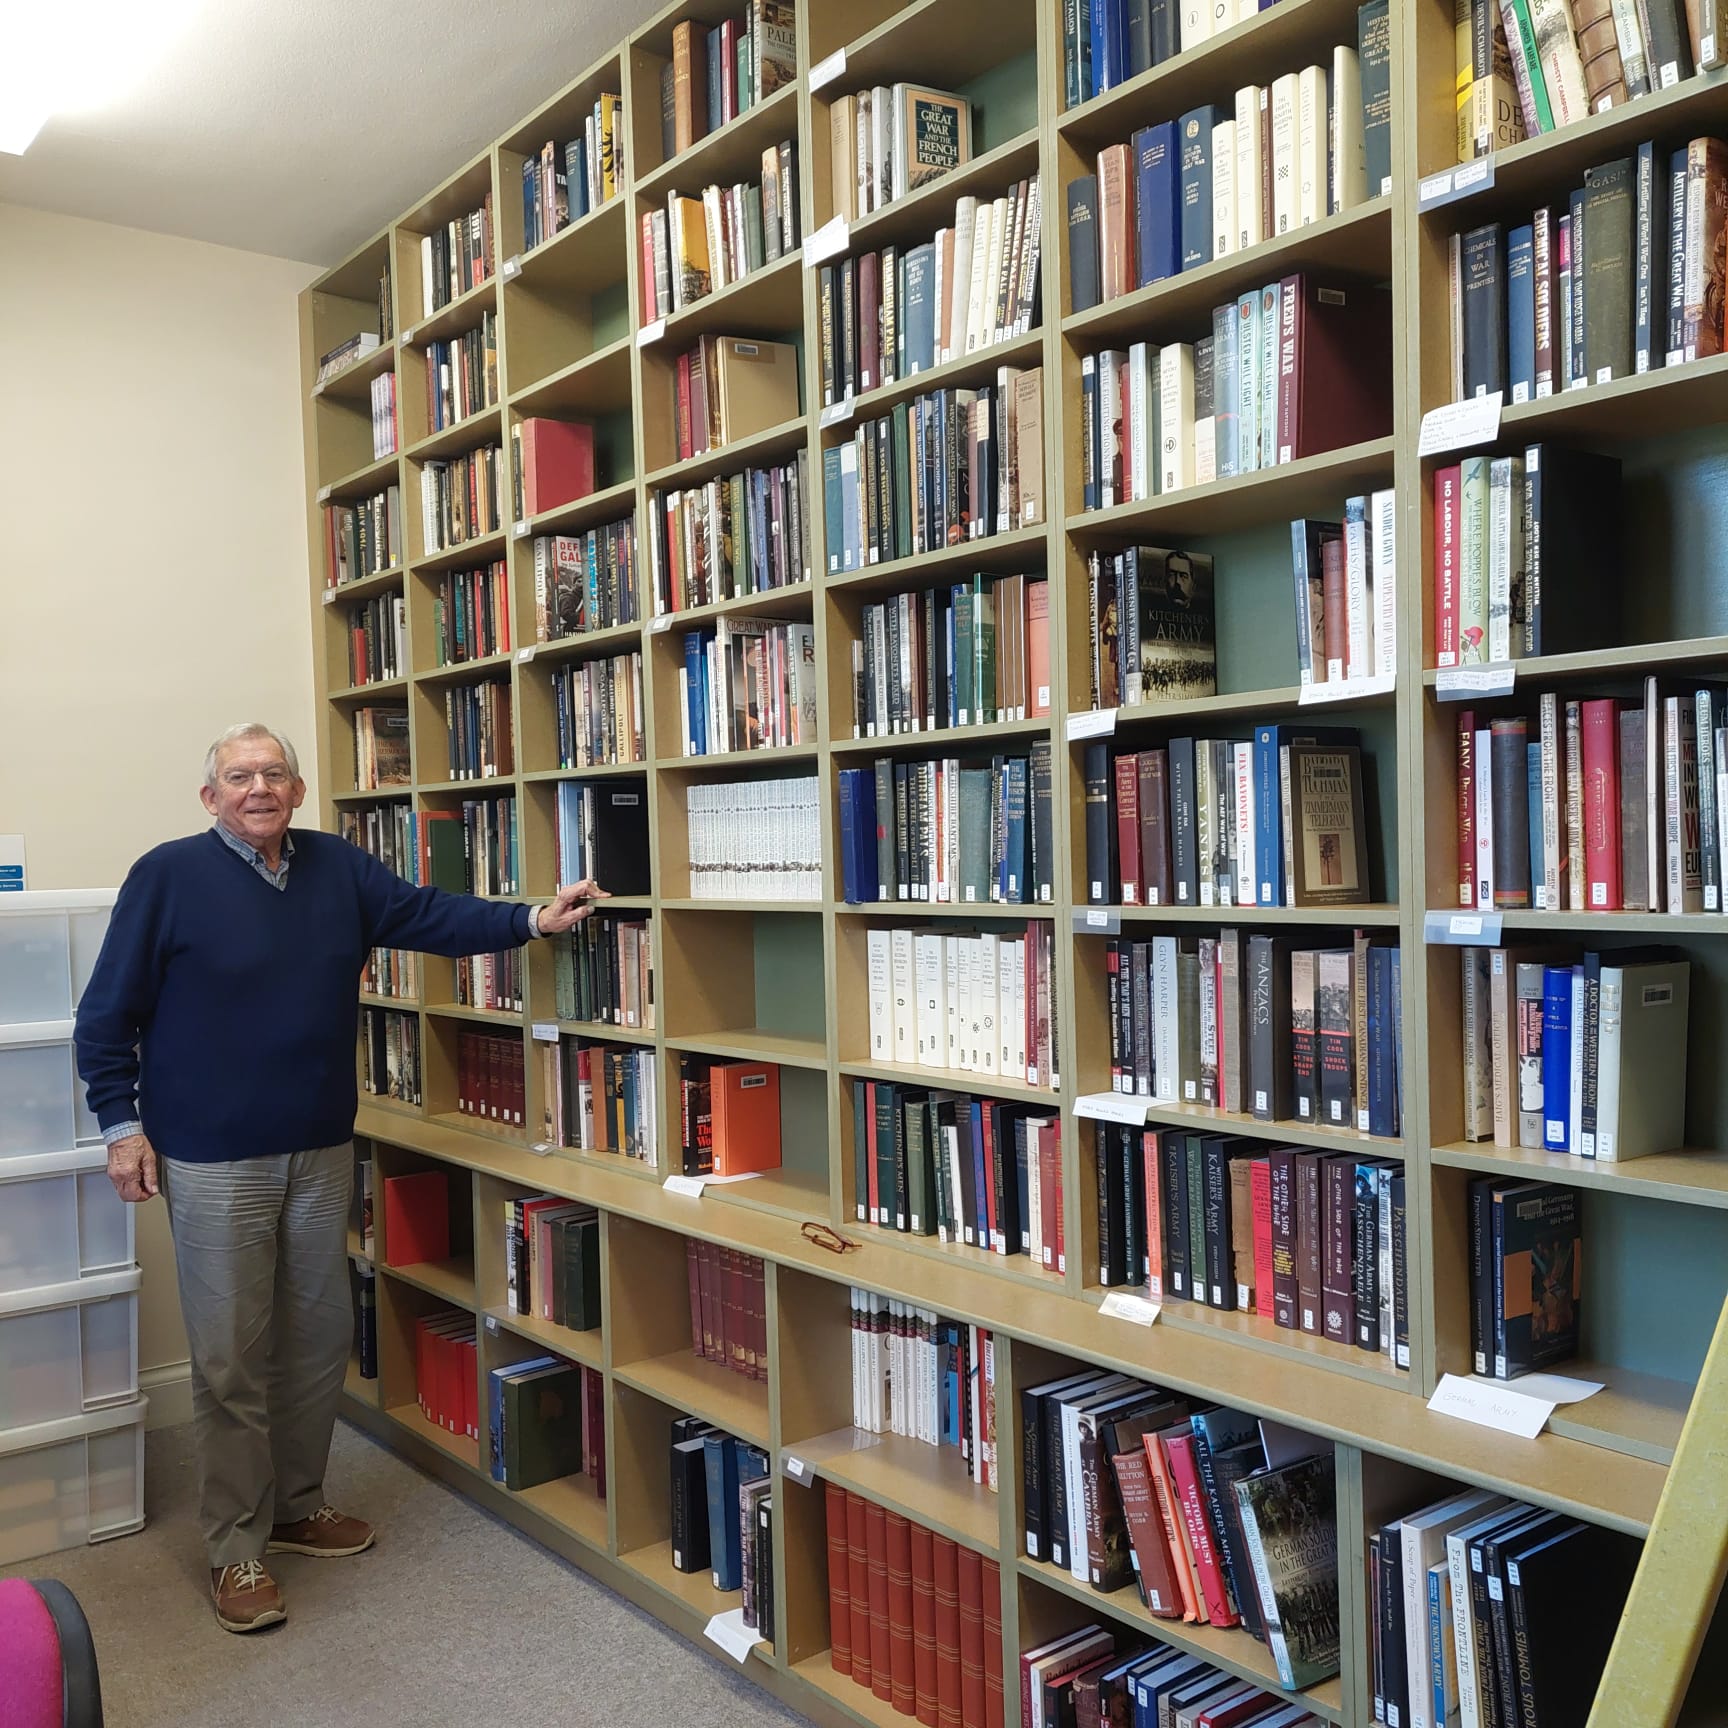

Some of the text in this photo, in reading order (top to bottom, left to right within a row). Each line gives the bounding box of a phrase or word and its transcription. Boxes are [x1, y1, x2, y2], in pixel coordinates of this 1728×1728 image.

[921, 109, 953, 124] GREAT
[926, 122, 949, 134] WAR
[918, 142, 958, 156] FRENCH
[918, 152, 954, 167] PEOPLE
[1640, 156, 1649, 180] Allied
[1639, 180, 1648, 212] Artillery
[1464, 238, 1496, 260] CHEMICALS IN
[1638, 222, 1648, 246] World
[1671, 171, 1686, 309] ARTILLERY IN THE GREAT WAR
[1470, 262, 1490, 273] WAR
[1638, 247, 1648, 263] War
[886, 328, 894, 356] PALS
[1282, 284, 1295, 376] FRED'S WAR
[1444, 480, 1452, 609] NO LABOUR, NO BATTLE
[1472, 498, 1482, 617] WHERE POPPIES BLOW
[1156, 622, 1204, 643] ARMY
[1684, 764, 1694, 782] IN
[1239, 752, 1248, 834] FIX BAYONETS!
[1200, 804, 1210, 876] YANKS
[1669, 816, 1678, 844] EUROPE
[1258, 963, 1270, 1025] ANZACS
[1207, 976, 1216, 1056] FLESH STEEL
[1280, 1164, 1290, 1236] THE OTHER SIDE
[1357, 1202, 1366, 1302] PASSCHENDAELE
[1366, 1220, 1376, 1292] GERMAN ARMY
[1394, 1206, 1405, 1322] PASSCHENDAELE
[1198, 1440, 1233, 1564] ALL THE KAISER'S MEN
[1184, 1502, 1200, 1549] BE OURS
[1188, 1484, 1213, 1565] VICTORY MUST
[1273, 1539, 1308, 1562] GERMAN
[1279, 1558, 1290, 1575] IN
[1291, 1554, 1306, 1571] THE
[1514, 1630, 1531, 1688] TOMMIES
